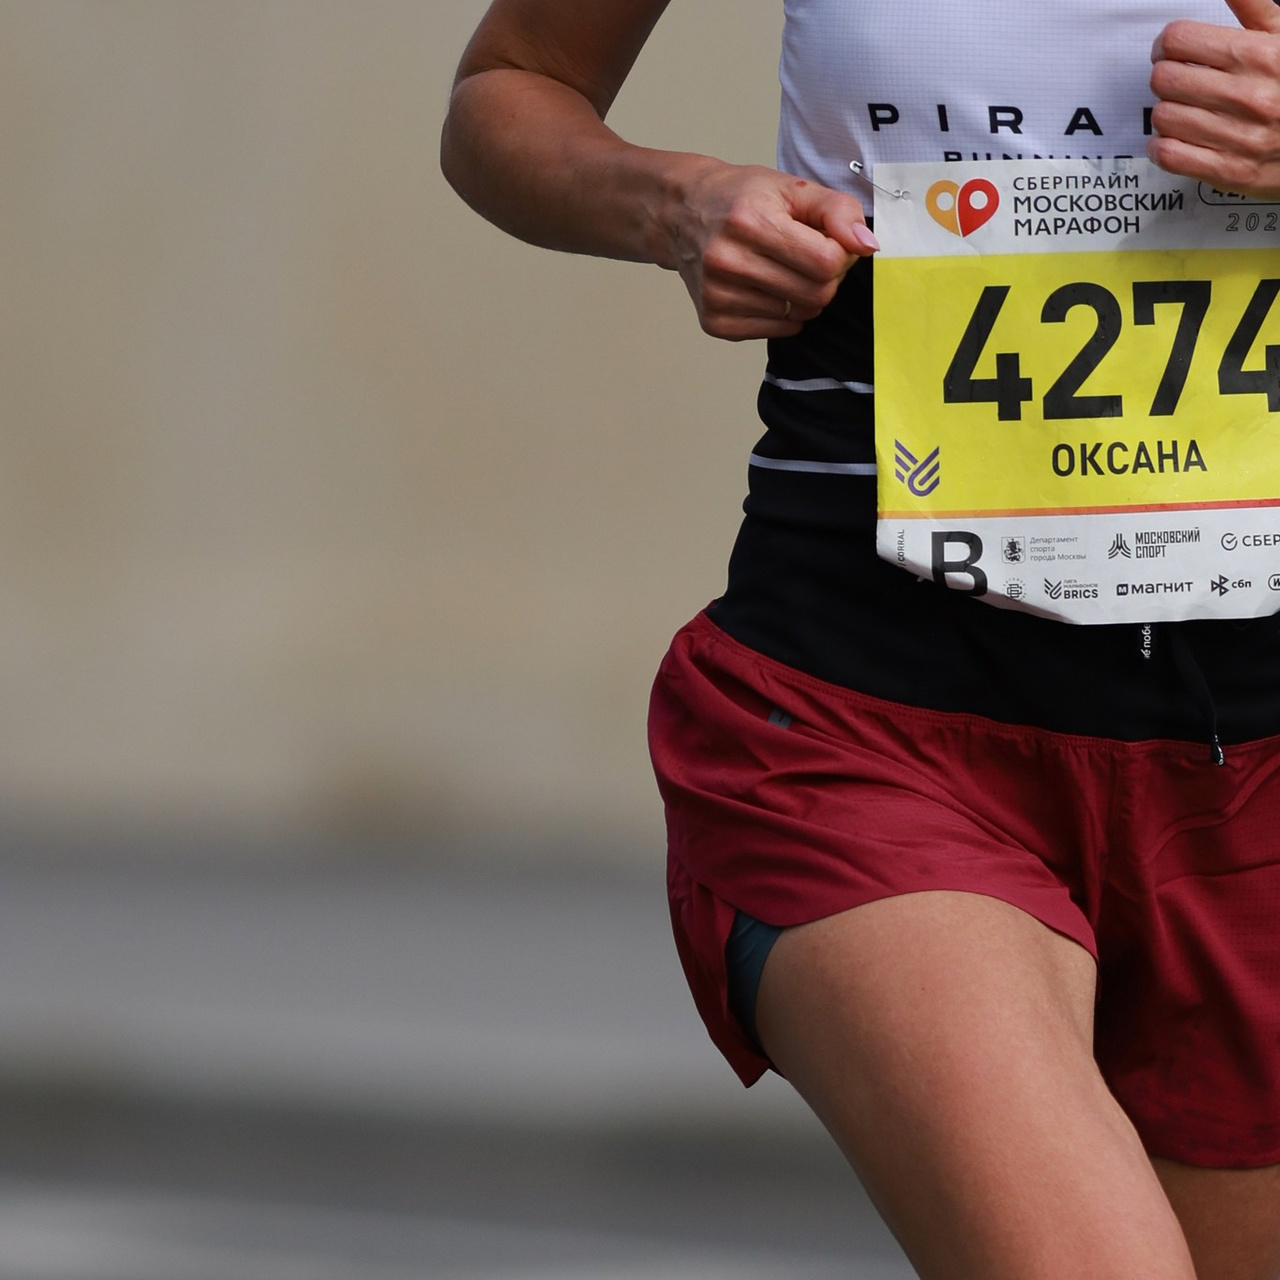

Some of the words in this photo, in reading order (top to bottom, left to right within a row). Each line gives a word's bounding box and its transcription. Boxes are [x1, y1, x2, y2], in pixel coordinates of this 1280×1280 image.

[868, 103, 1152, 136] PIRA
[1013, 174, 1139, 192] СБЕРПРАЙМ
[1013, 190, 1184, 214] МОСКОВСКИЙ
[1013, 215, 1140, 236] МАРАФОН
[1052, 439, 1207, 477] ОКСАНА
[1030, 536, 1079, 545] Департамент
[1135, 526, 1201, 545] МОСКОВСКИЙ
[1030, 546, 1055, 554] спорта
[1030, 554, 1056, 562] города
[1057, 553, 1087, 561] Москвы
[1135, 544, 1167, 559] СПОРТ
[931, 531, 988, 597] B
[1131, 581, 1193, 595] магнит
[1231, 579, 1252, 590] сбп
[1064, 589, 1098, 599] BRICS
